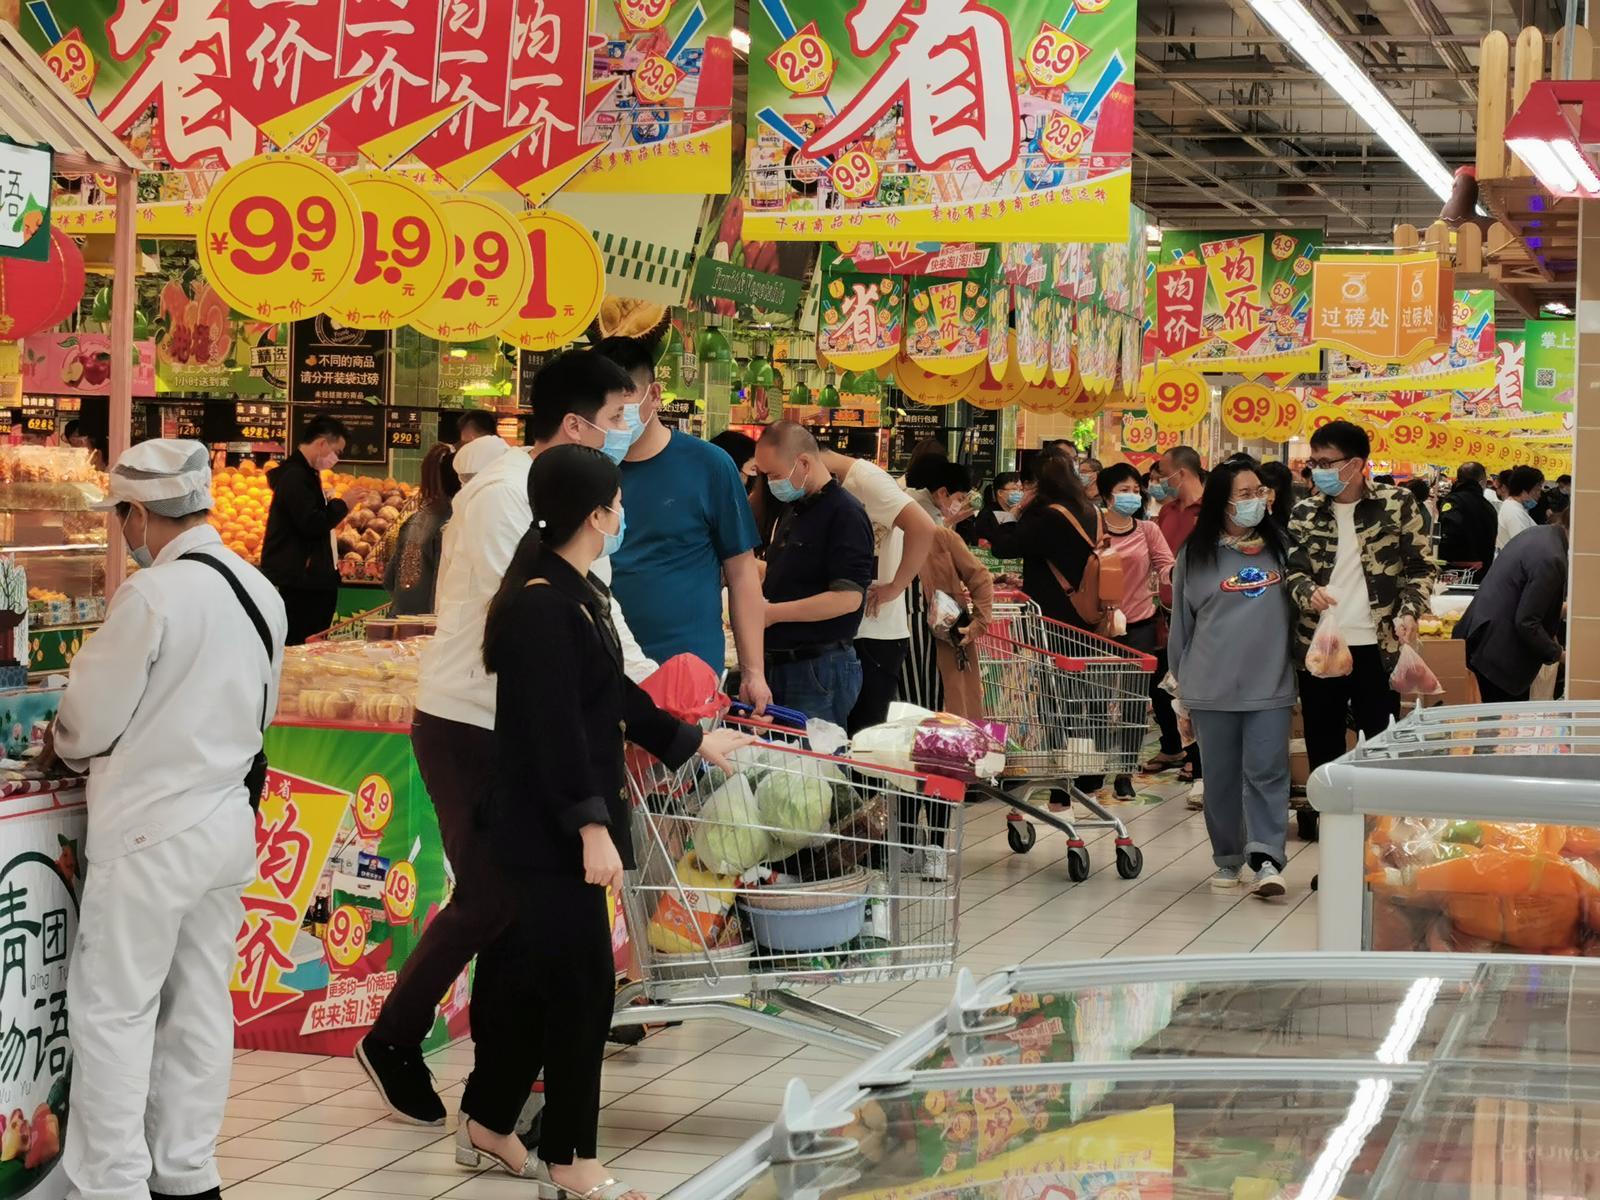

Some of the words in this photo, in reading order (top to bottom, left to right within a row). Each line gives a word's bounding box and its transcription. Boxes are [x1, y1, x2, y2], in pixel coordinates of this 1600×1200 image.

[780, 37, 824, 83] 2.9
[1032, 34, 1077, 74] 6.9
[510, 0, 575, 169] 均一价
[638, 58, 676, 96] 29.9
[803, 0, 1015, 176] 省
[1046, 119, 1083, 154] 29.9
[835, 154, 872, 191] 9.9
[775, 212, 901, 233] 千样商品均一价
[1273, 236, 1293, 252] 4.9
[311, 268, 326, 283] 元
[518, 228, 557, 319] 1
[563, 304, 575, 317] 元
[401, 283, 416, 297] 元
[486, 294, 499, 307] 元
[1219, 246, 1265, 334] 均一价
[1273, 283, 1292, 299] 6.9
[256, 301, 306, 317] 均一价
[346, 307, 395, 325] 均一价
[831, 284, 879, 345] 省
[939, 289, 960, 341] 均一价
[1163, 269, 1199, 349] 均一价
[1321, 306, 1390, 328] 过磅处
[1402, 305, 1434, 328] 过磅处
[437, 325, 483, 337] 均一价
[519, 332, 560, 345] 均一价
[318, 354, 376, 369] 不同的商品
[440, 363, 495, 377] 上大润发
[300, 370, 380, 386] 请分开装袋过磅
[360, 781, 389, 820] 4.9
[387, 869, 416, 908] 19.9
[235, 801, 311, 1008] 均一价
[329, 909, 363, 955] 9.9
[30, 973, 50, 991] Qing
[329, 973, 398, 999] 更多均一价商品
